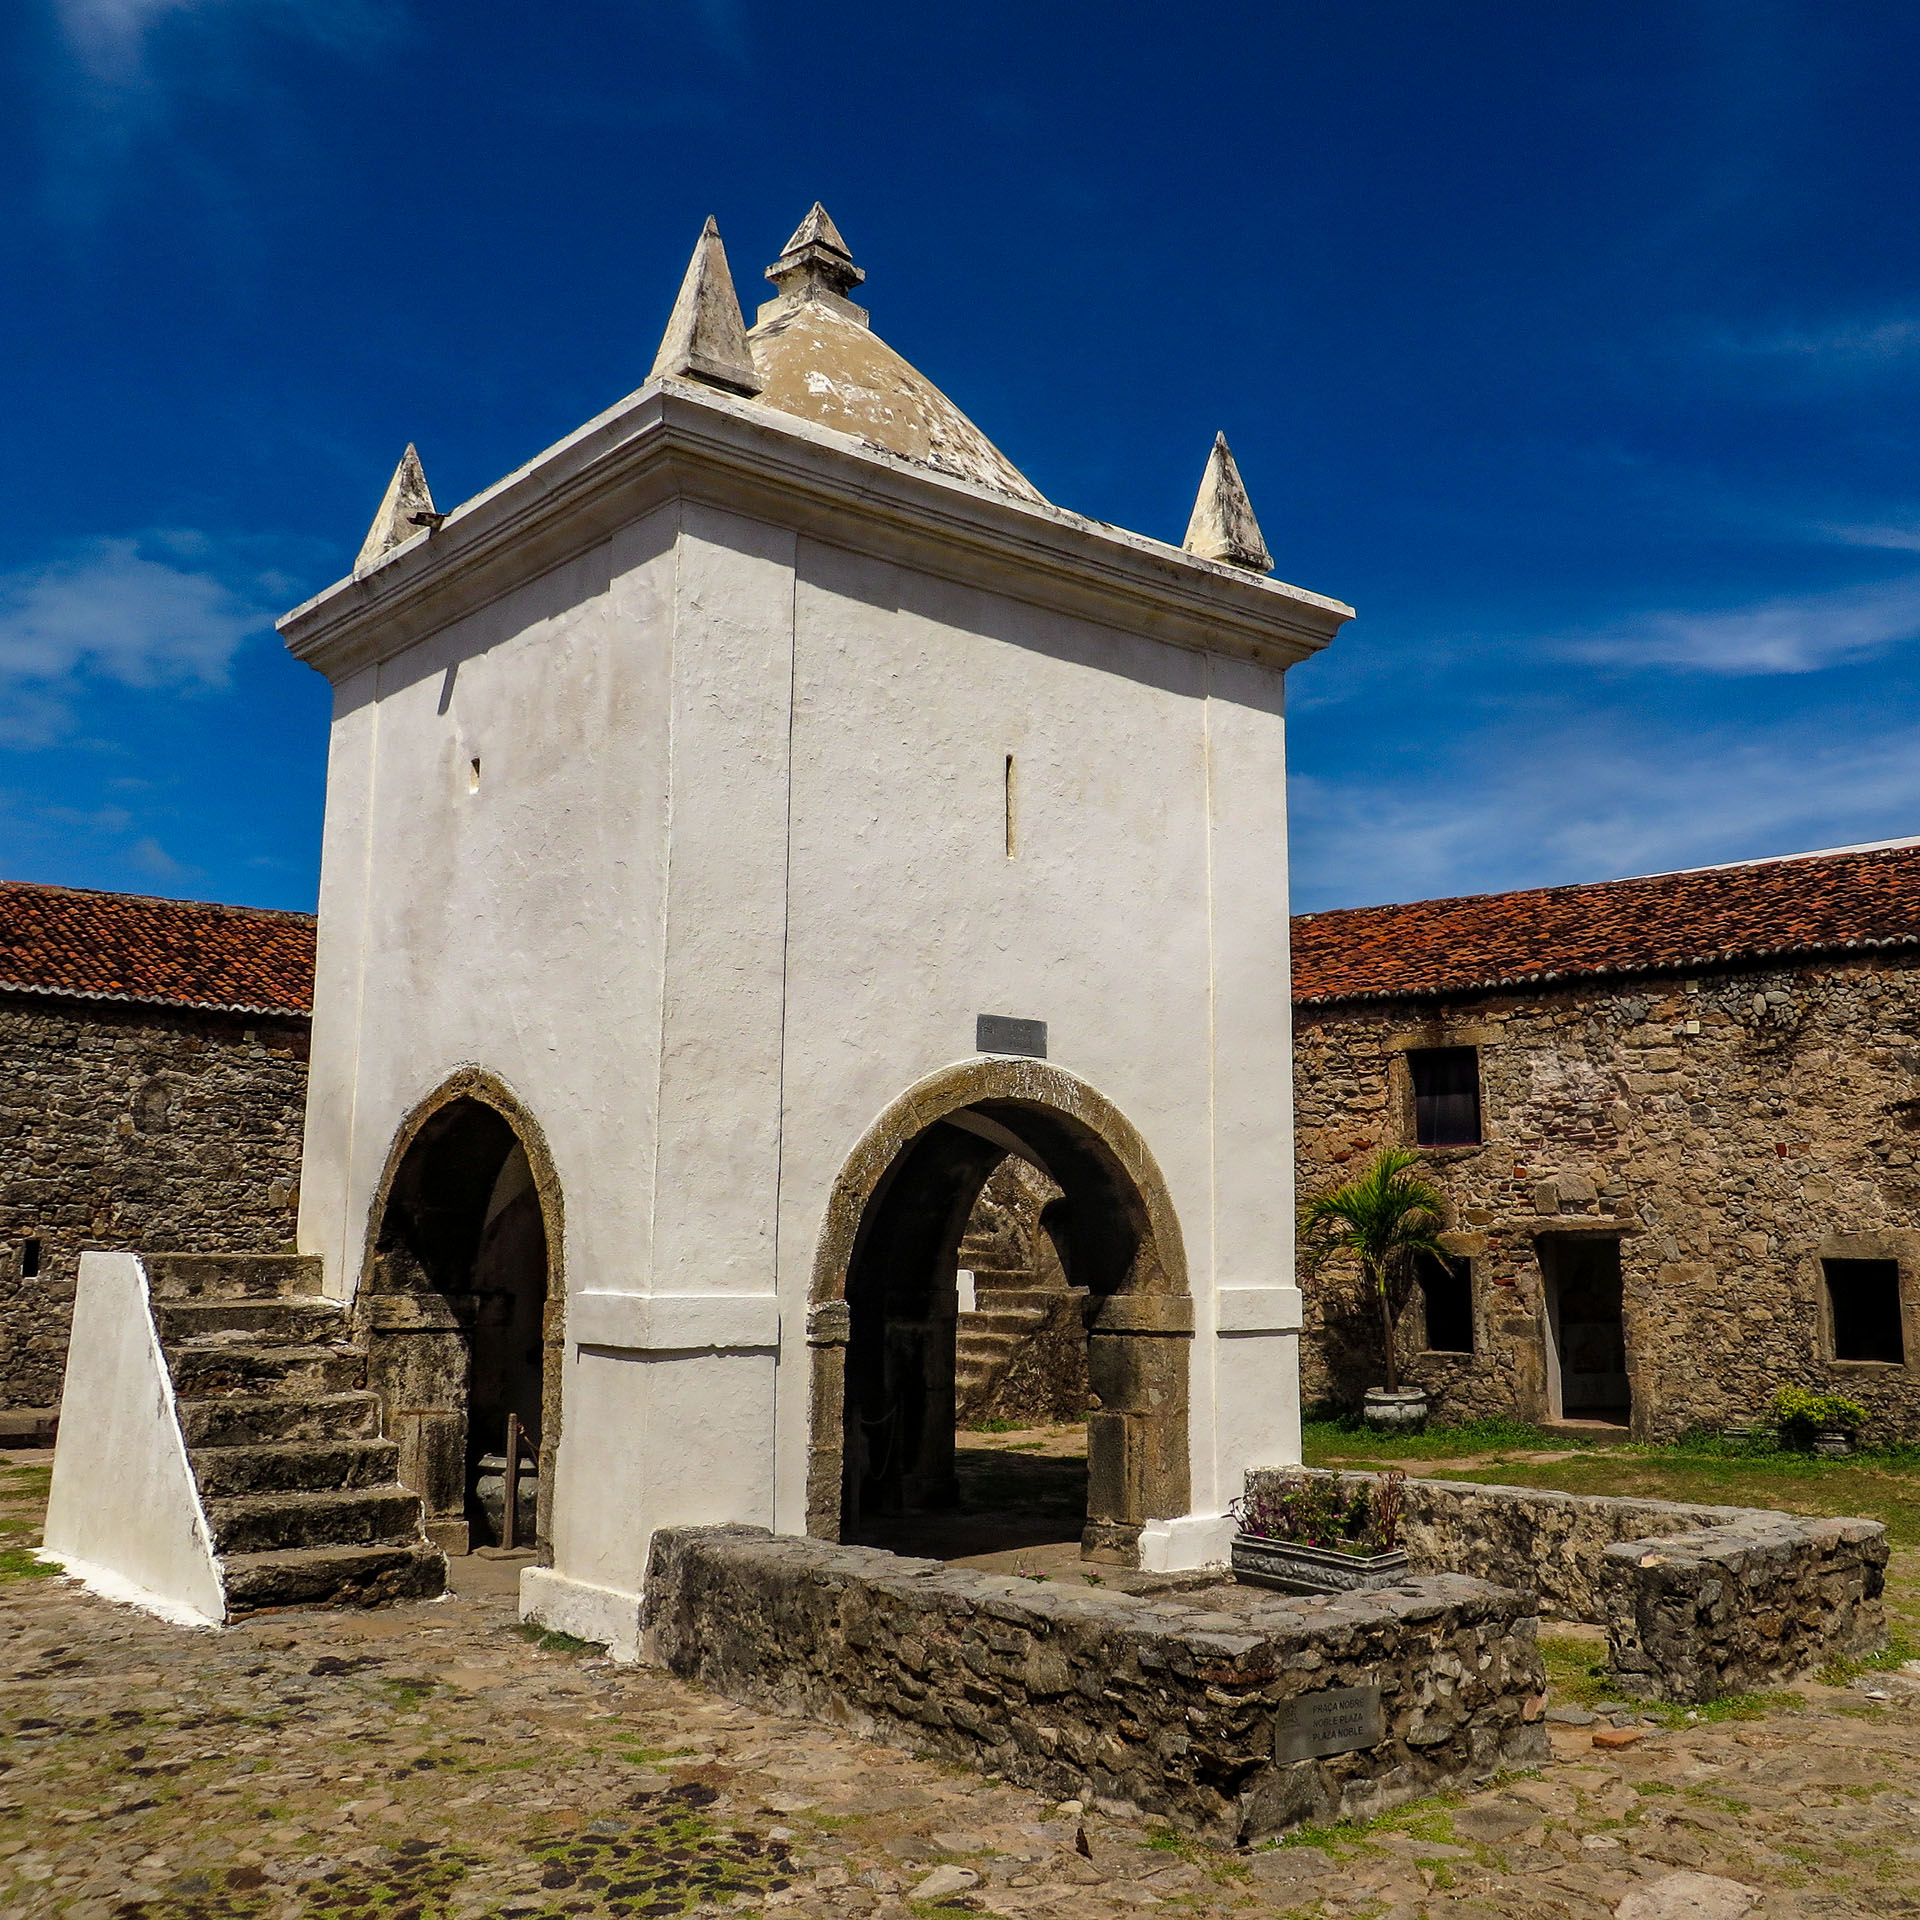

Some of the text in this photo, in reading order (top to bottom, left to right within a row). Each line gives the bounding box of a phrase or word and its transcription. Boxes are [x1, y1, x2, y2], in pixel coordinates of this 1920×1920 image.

[1313, 1698, 1365, 1714] PRAÇA NOBRE
[1313, 1716, 1337, 1727] NOBLE
[1339, 1712, 1363, 1724] PLAZA
[1313, 1726, 1363, 1741] PLAZA NOBLE
